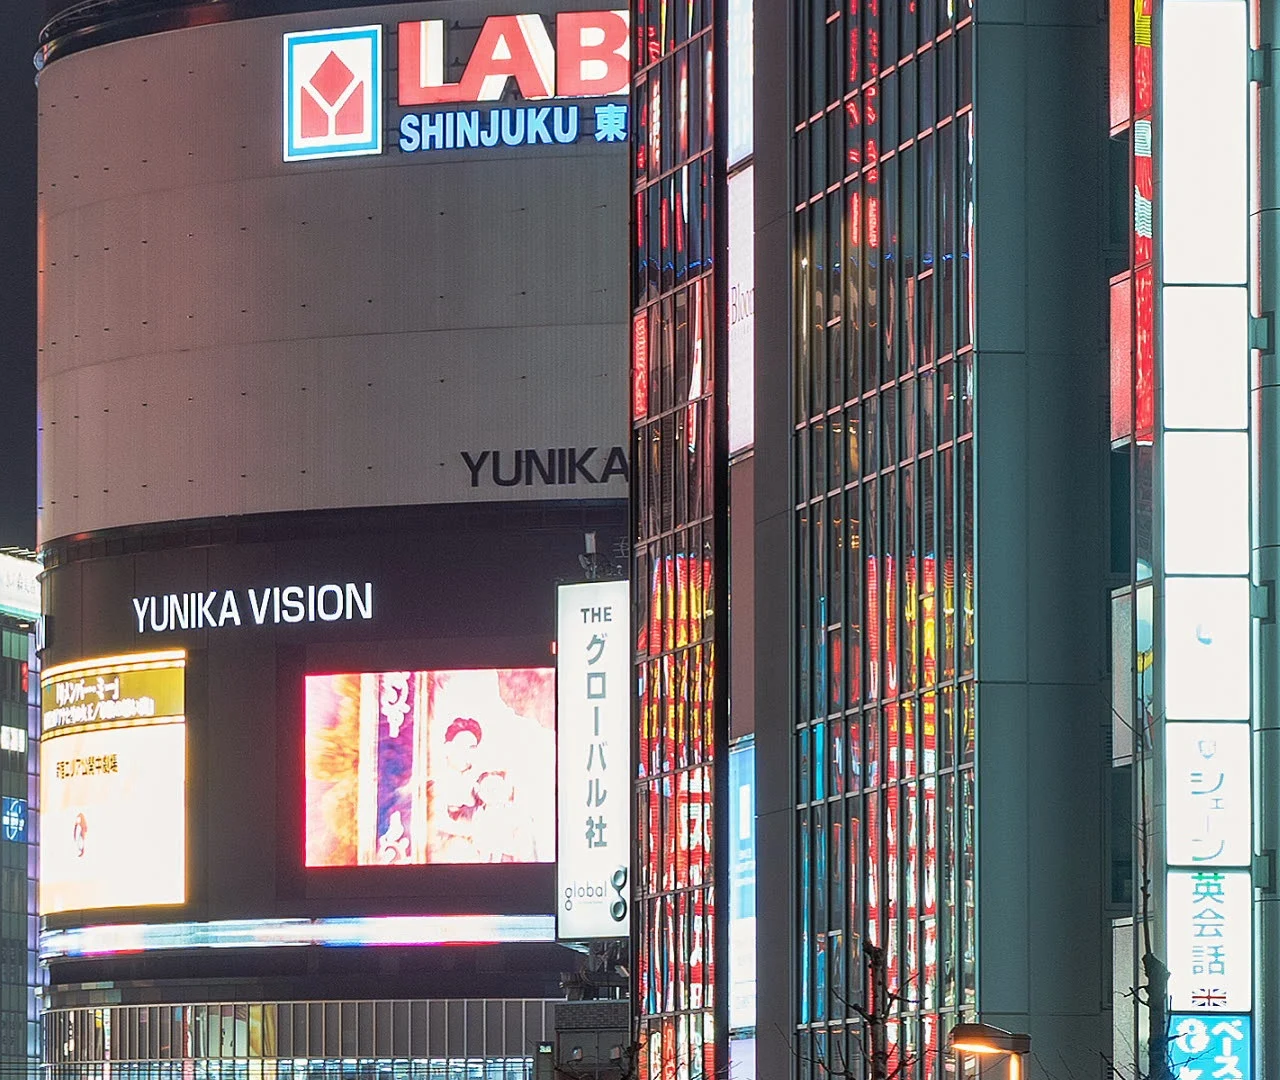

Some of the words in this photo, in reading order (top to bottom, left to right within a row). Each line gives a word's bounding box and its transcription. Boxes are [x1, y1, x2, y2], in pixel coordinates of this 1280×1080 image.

[399, 106, 577, 153] SHINJUKU
[461, 446, 630, 488] YUNIKA
[132, 589, 240, 633] YUNIKA
[248, 581, 374, 625] VISION
[580, 606, 612, 624] THE
[584, 631, 609, 849] グローバル社
[1190, 772, 1225, 862] シェーン
[564, 879, 608, 911] global
[1192, 871, 1226, 976] 英会話
